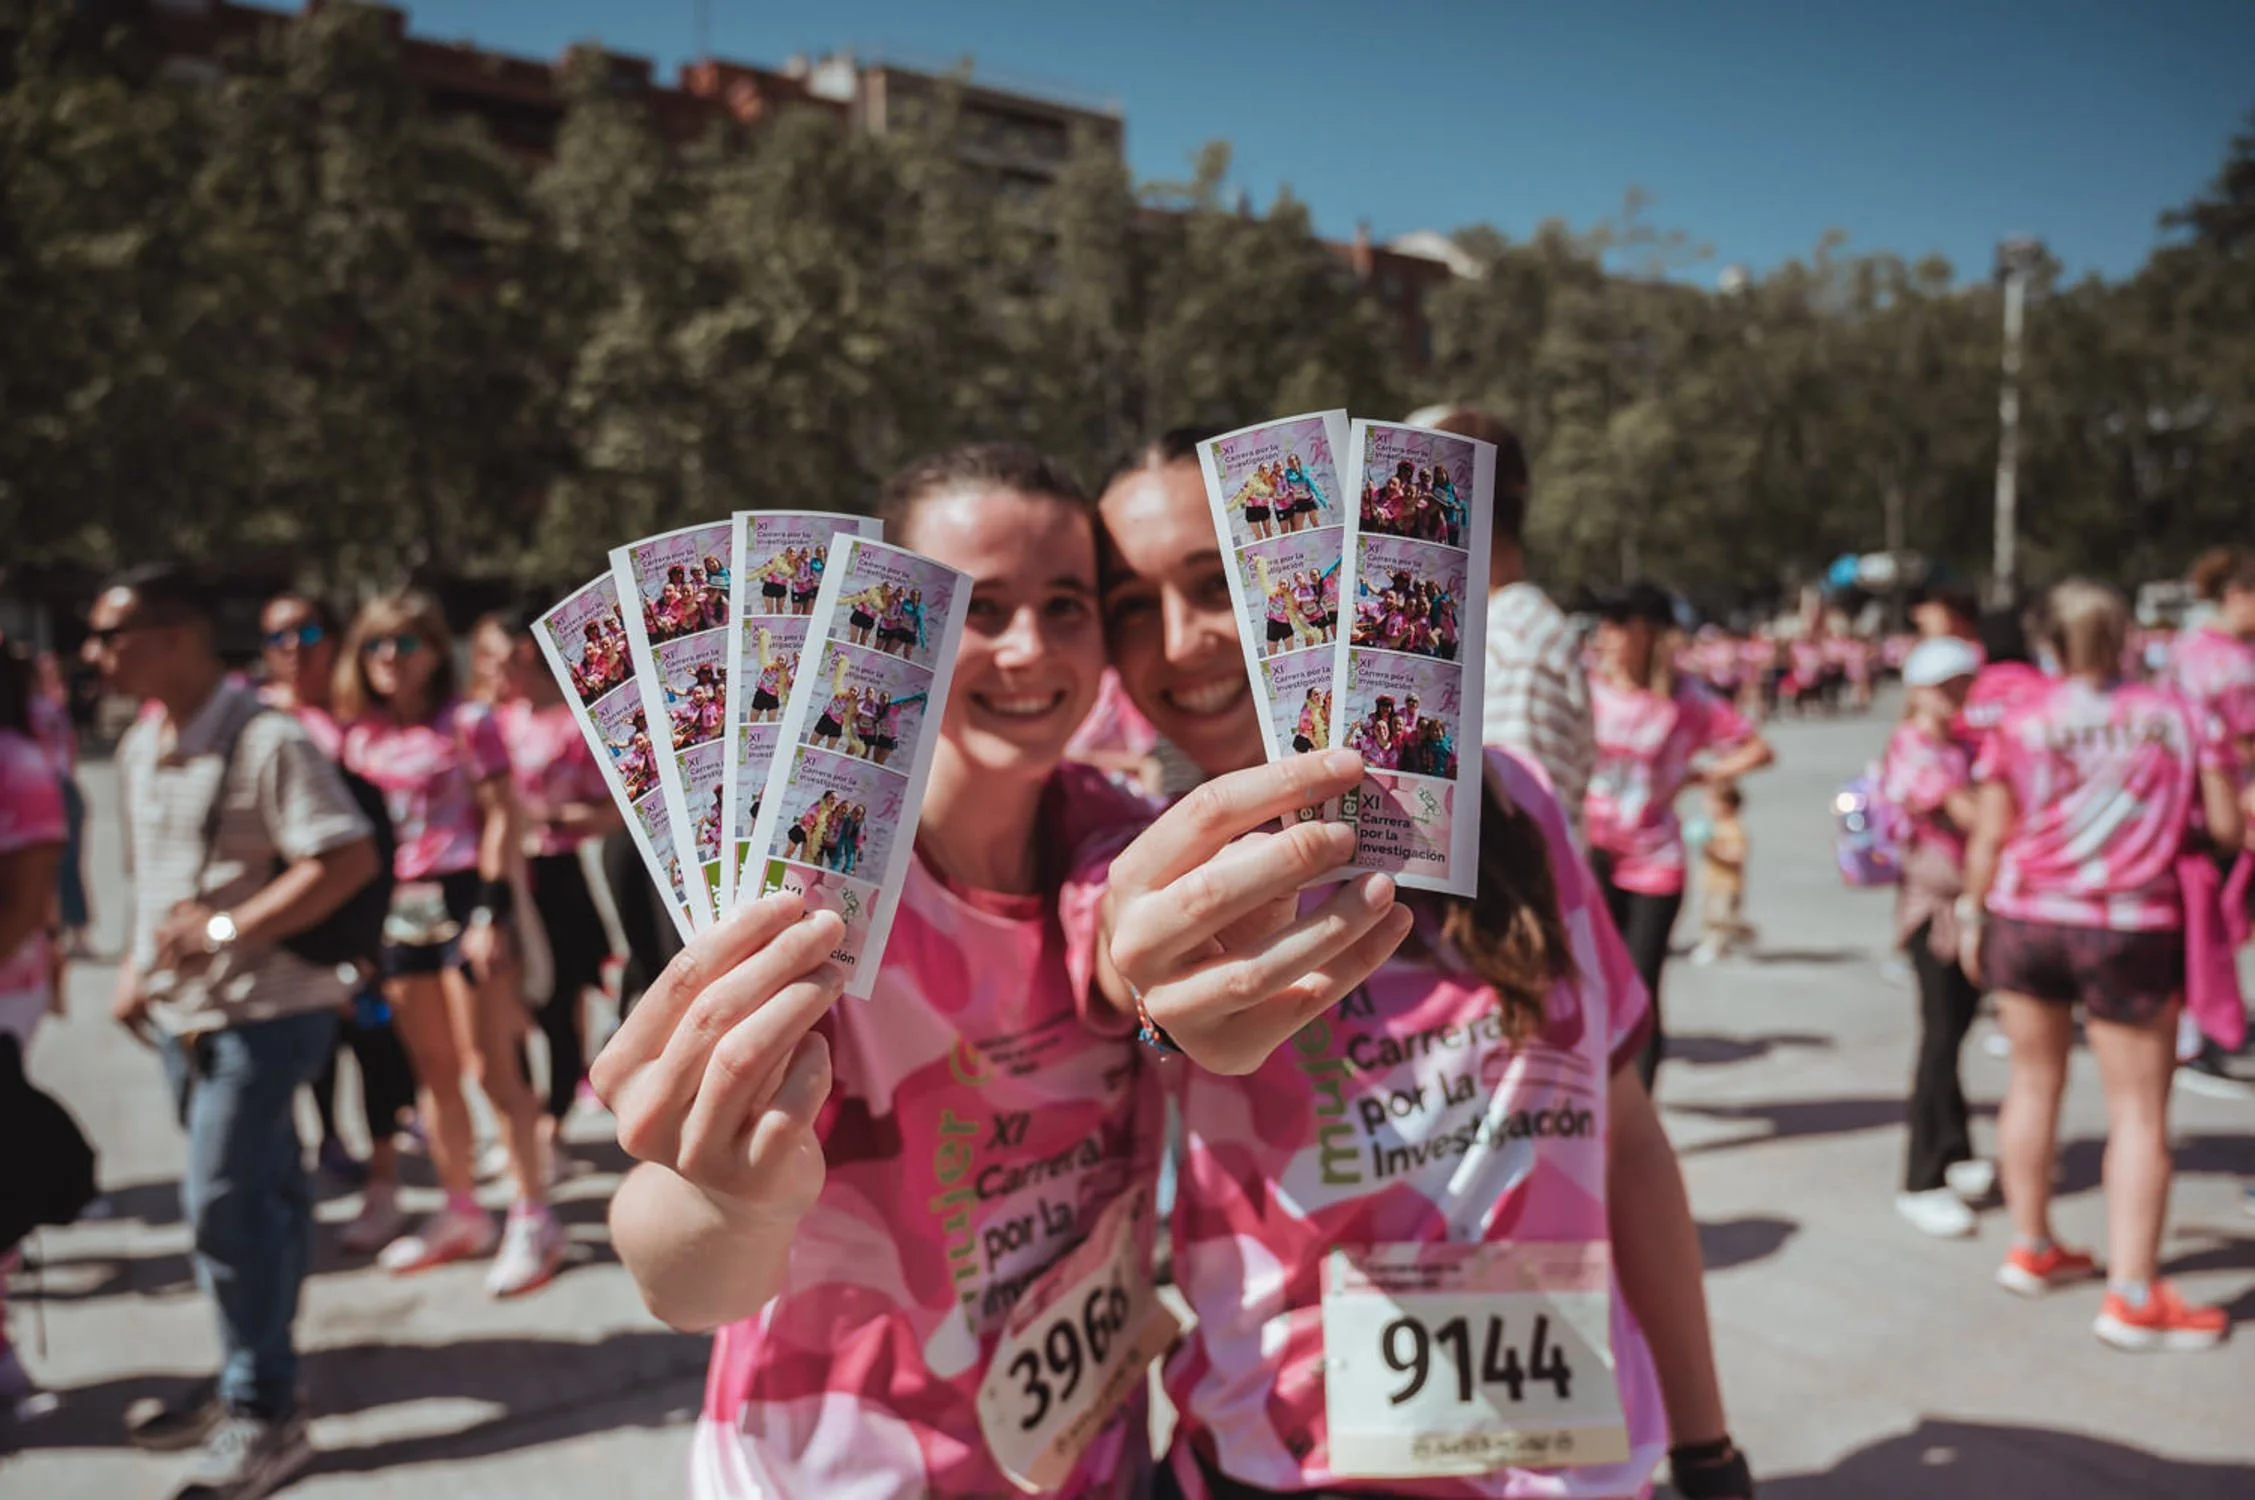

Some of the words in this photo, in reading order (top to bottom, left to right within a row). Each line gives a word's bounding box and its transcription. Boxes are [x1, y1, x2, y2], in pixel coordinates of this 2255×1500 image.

[1360, 828, 1383, 841] por
[1386, 829, 1398, 841] la
[1361, 812, 1411, 829] Carrera
[1362, 793, 1380, 810] XI
[1347, 1010, 1504, 1071] Carrera
[1293, 1016, 1362, 1185] muje
[1357, 1082, 1427, 1136] por
[1437, 1070, 1476, 1107] la
[975, 1135, 1101, 1201] Carrera
[984, 1215, 1035, 1274] por
[1037, 1195, 1074, 1238] la
[1381, 1313, 1573, 1406] 9144
